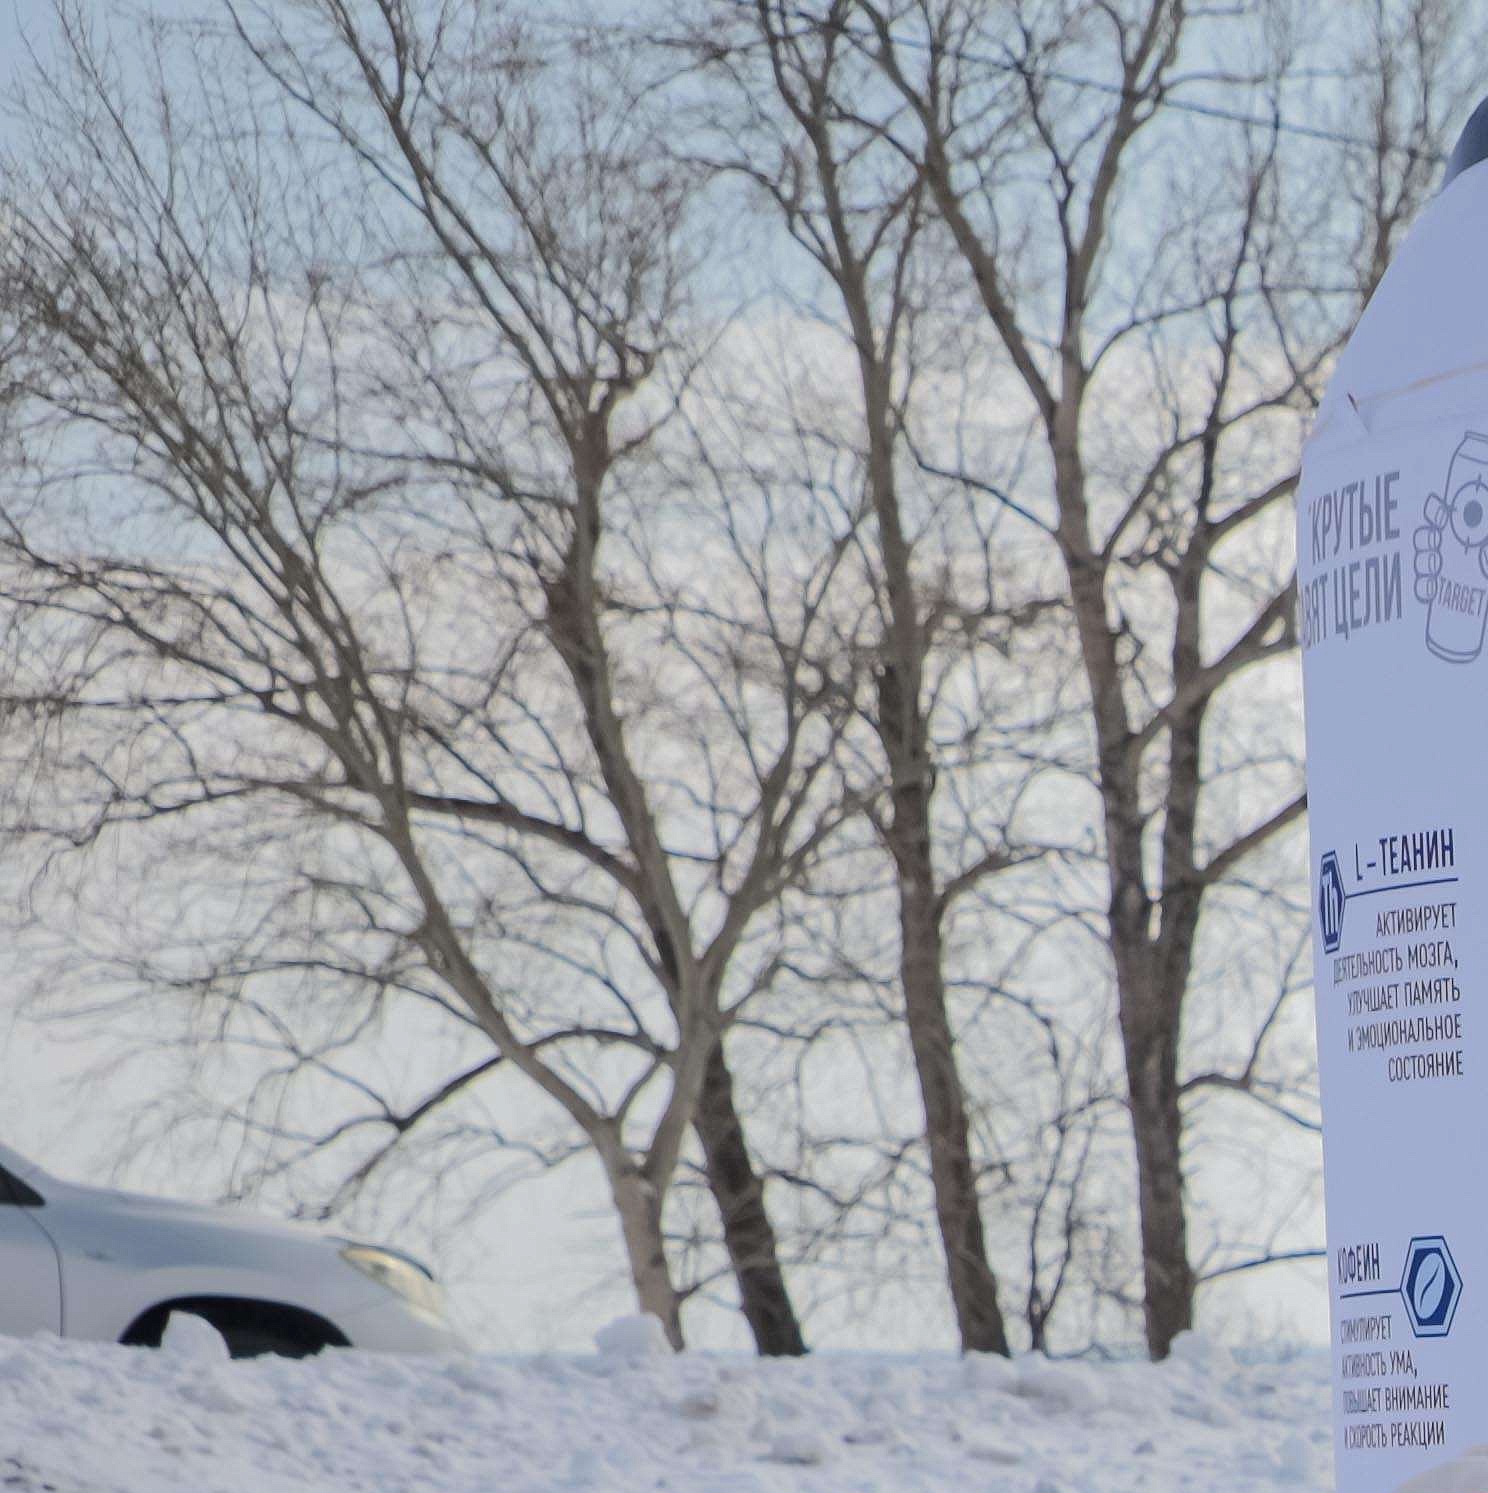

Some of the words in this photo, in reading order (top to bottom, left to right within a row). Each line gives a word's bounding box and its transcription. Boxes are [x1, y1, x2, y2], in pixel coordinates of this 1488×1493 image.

[1334, 552, 1402, 641] ЦЕЛИ
[1438, 577, 1486, 617] TARGET
[1375, 902, 1457, 938] АКТИВИРУЕТ
[1333, 948, 1403, 986] ДЕЯТЕЛЬНОСТЬ
[1407, 941, 1459, 969] МОЗГА,
[1347, 983, 1399, 1016] УЛУЧШАЕТ
[1403, 977, 1461, 1008] ПАМЯТЬ
[1356, 1013, 1462, 1052] ЭМОЦИОНАЛЬНОЕ
[1387, 1050, 1464, 1082] СОСТОЯНИЕ
[1337, 1242, 1380, 1285] КОФЕИН
[1389, 1350, 1418, 1379] УМА,
[1385, 1383, 1450, 1412] ВНИМАНИЕ
[1390, 1420, 1445, 1450] РЕАКЦИИ
